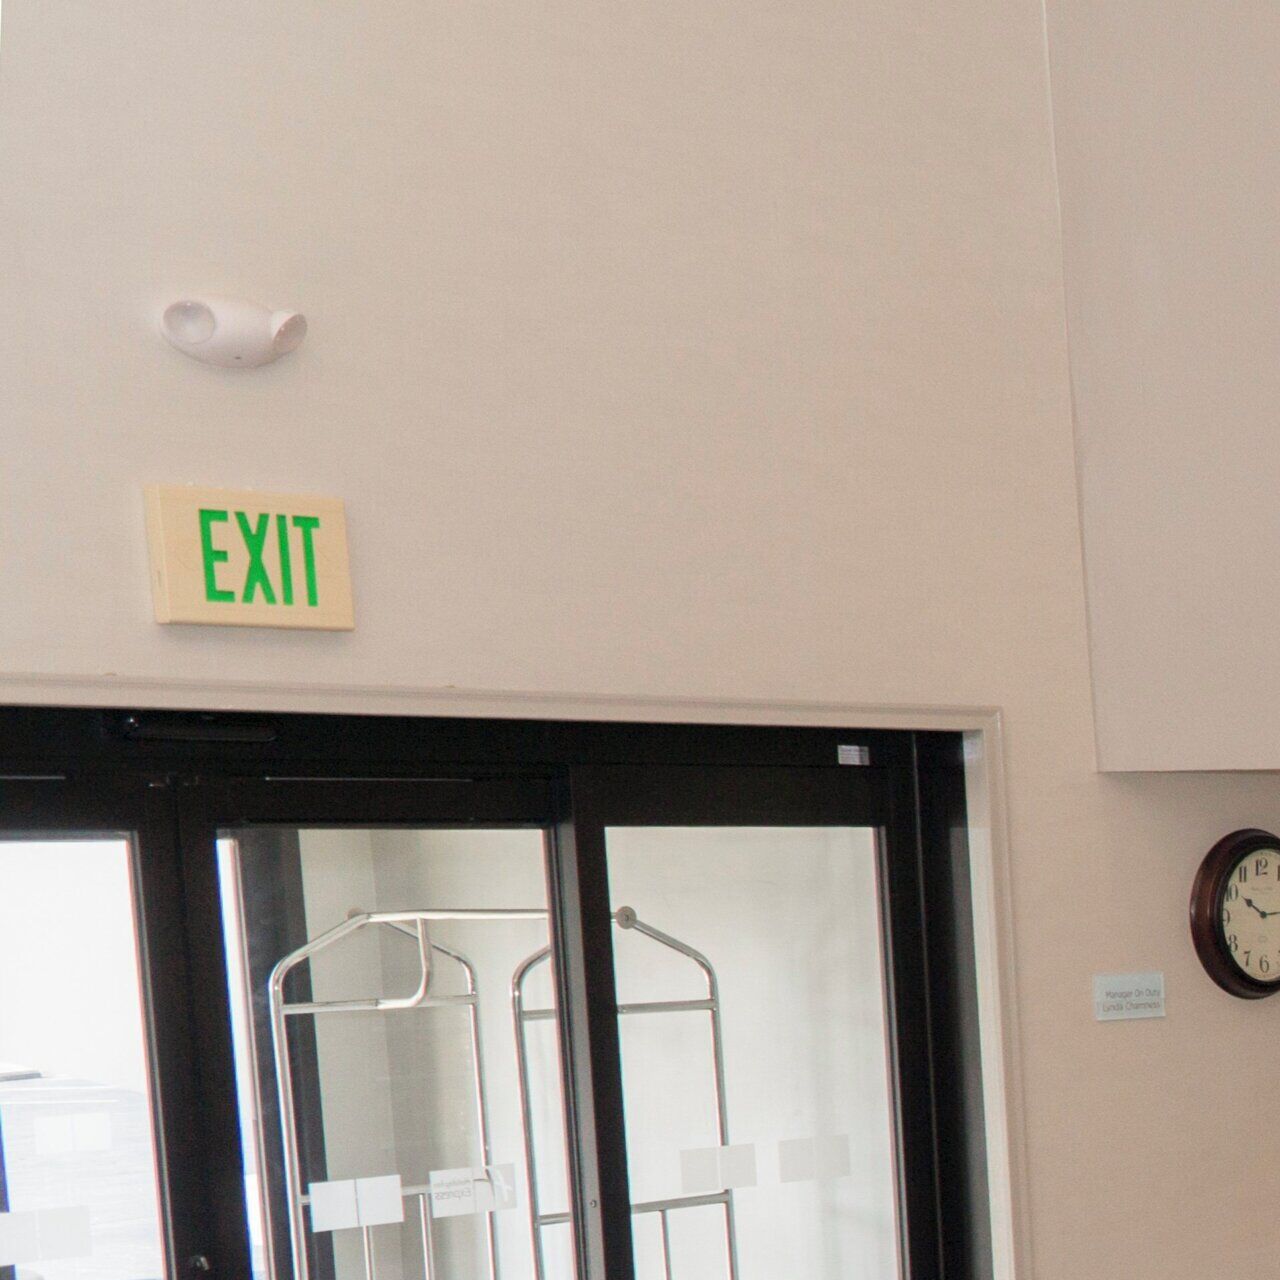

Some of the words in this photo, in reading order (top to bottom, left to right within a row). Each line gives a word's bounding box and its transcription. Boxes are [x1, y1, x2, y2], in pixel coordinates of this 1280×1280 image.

[198, 508, 320, 607] EXIT
[1239, 866, 1247, 882] 11
[1255, 858, 1268, 876] 12
[1277, 864, 1280, 881] 1
[1229, 934, 1238, 952] 8
[1243, 950, 1251, 967] 7
[1259, 954, 1270, 973] 6
